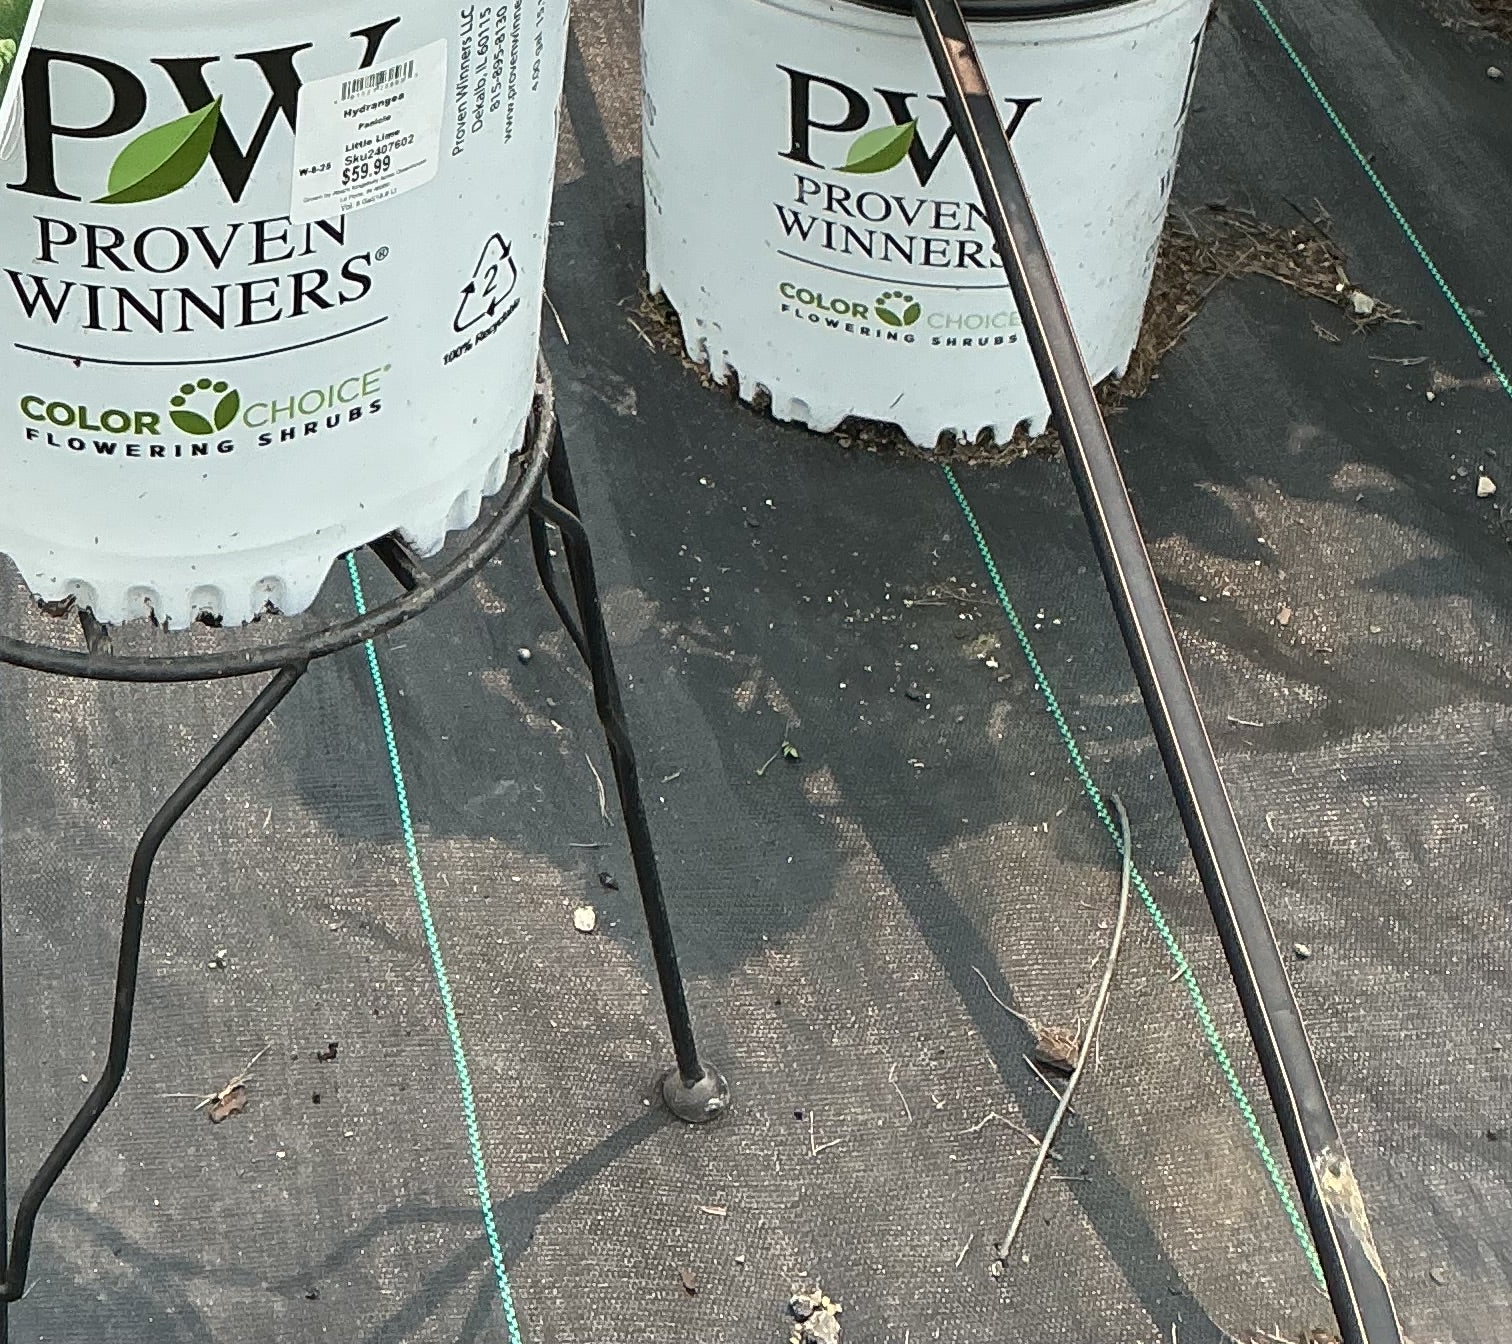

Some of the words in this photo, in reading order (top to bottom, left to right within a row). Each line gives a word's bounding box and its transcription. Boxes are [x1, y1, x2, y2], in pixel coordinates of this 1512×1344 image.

[461, 4, 475, 34] LLC
[477, 7, 492, 55] 60115
[456, 36, 473, 103] Winners
[478, 55, 489, 73] IL
[490, 5, 508, 113] 815-895-8130
[344, 92, 405, 119] Hydrangea
[472, 73, 487, 133] Dekalb,
[344, 134, 415, 166] Sku2407602
[345, 139, 373, 153] Little
[375, 129, 401, 142] Lime
[452, 102, 468, 156] Proven
[341, 155, 391, 186] $59.99
[792, 173, 993, 233] PROVEN
[33, 214, 347, 274] PROVEN
[482, 264, 498, 297] 2
[779, 282, 869, 321] COLOR
[927, 310, 1020, 330] CHOICE
[781, 303, 916, 345] FLOWERING
[931, 333, 1019, 348] SHRUBS
[443, 338, 473, 366] 100%
[20, 395, 161, 435] COLOR
[243, 367, 383, 429] CHOICE
[25, 428, 235, 459] FLOWERING
[258, 399, 383, 447] SHRUBS
